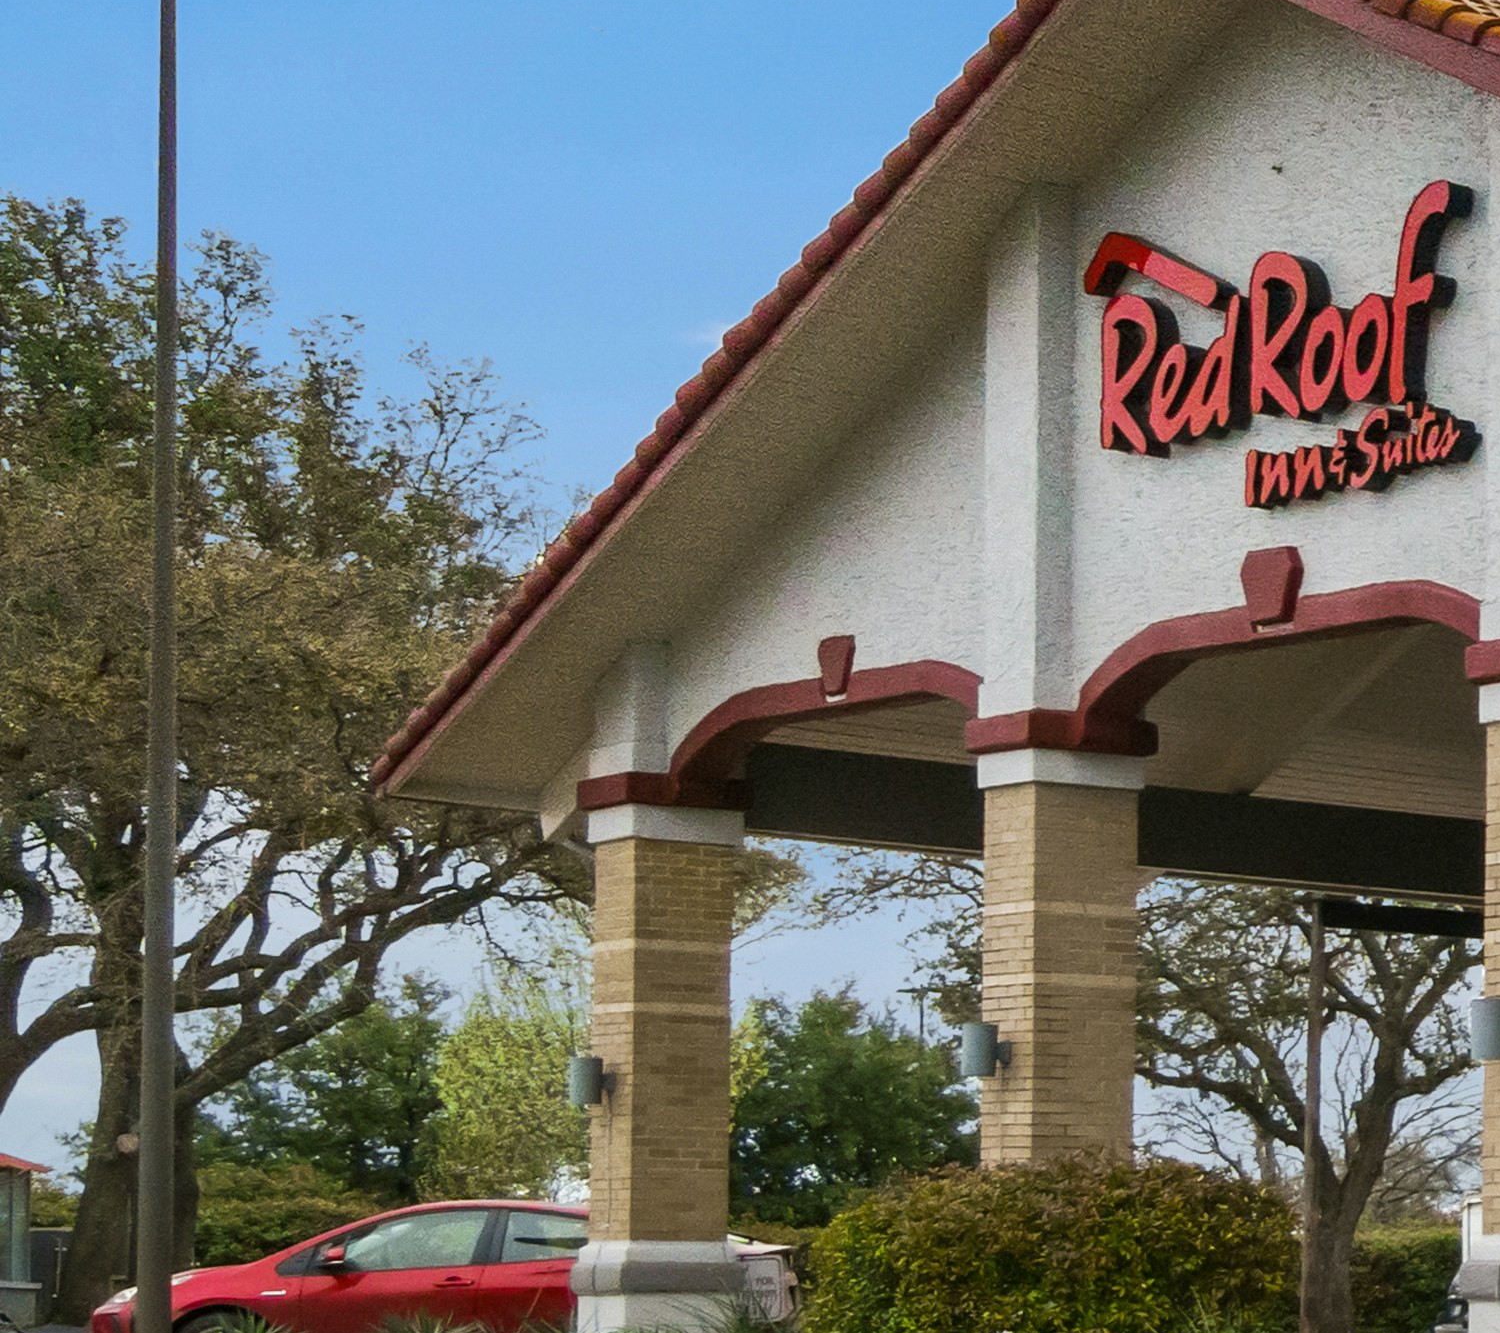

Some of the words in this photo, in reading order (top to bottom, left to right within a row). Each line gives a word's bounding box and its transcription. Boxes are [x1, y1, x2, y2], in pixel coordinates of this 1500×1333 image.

[1101, 291, 1244, 455] Red
[1249, 179, 1460, 420] Roof
[1244, 442, 1325, 508] Inn
[1350, 401, 1464, 489] Suites
